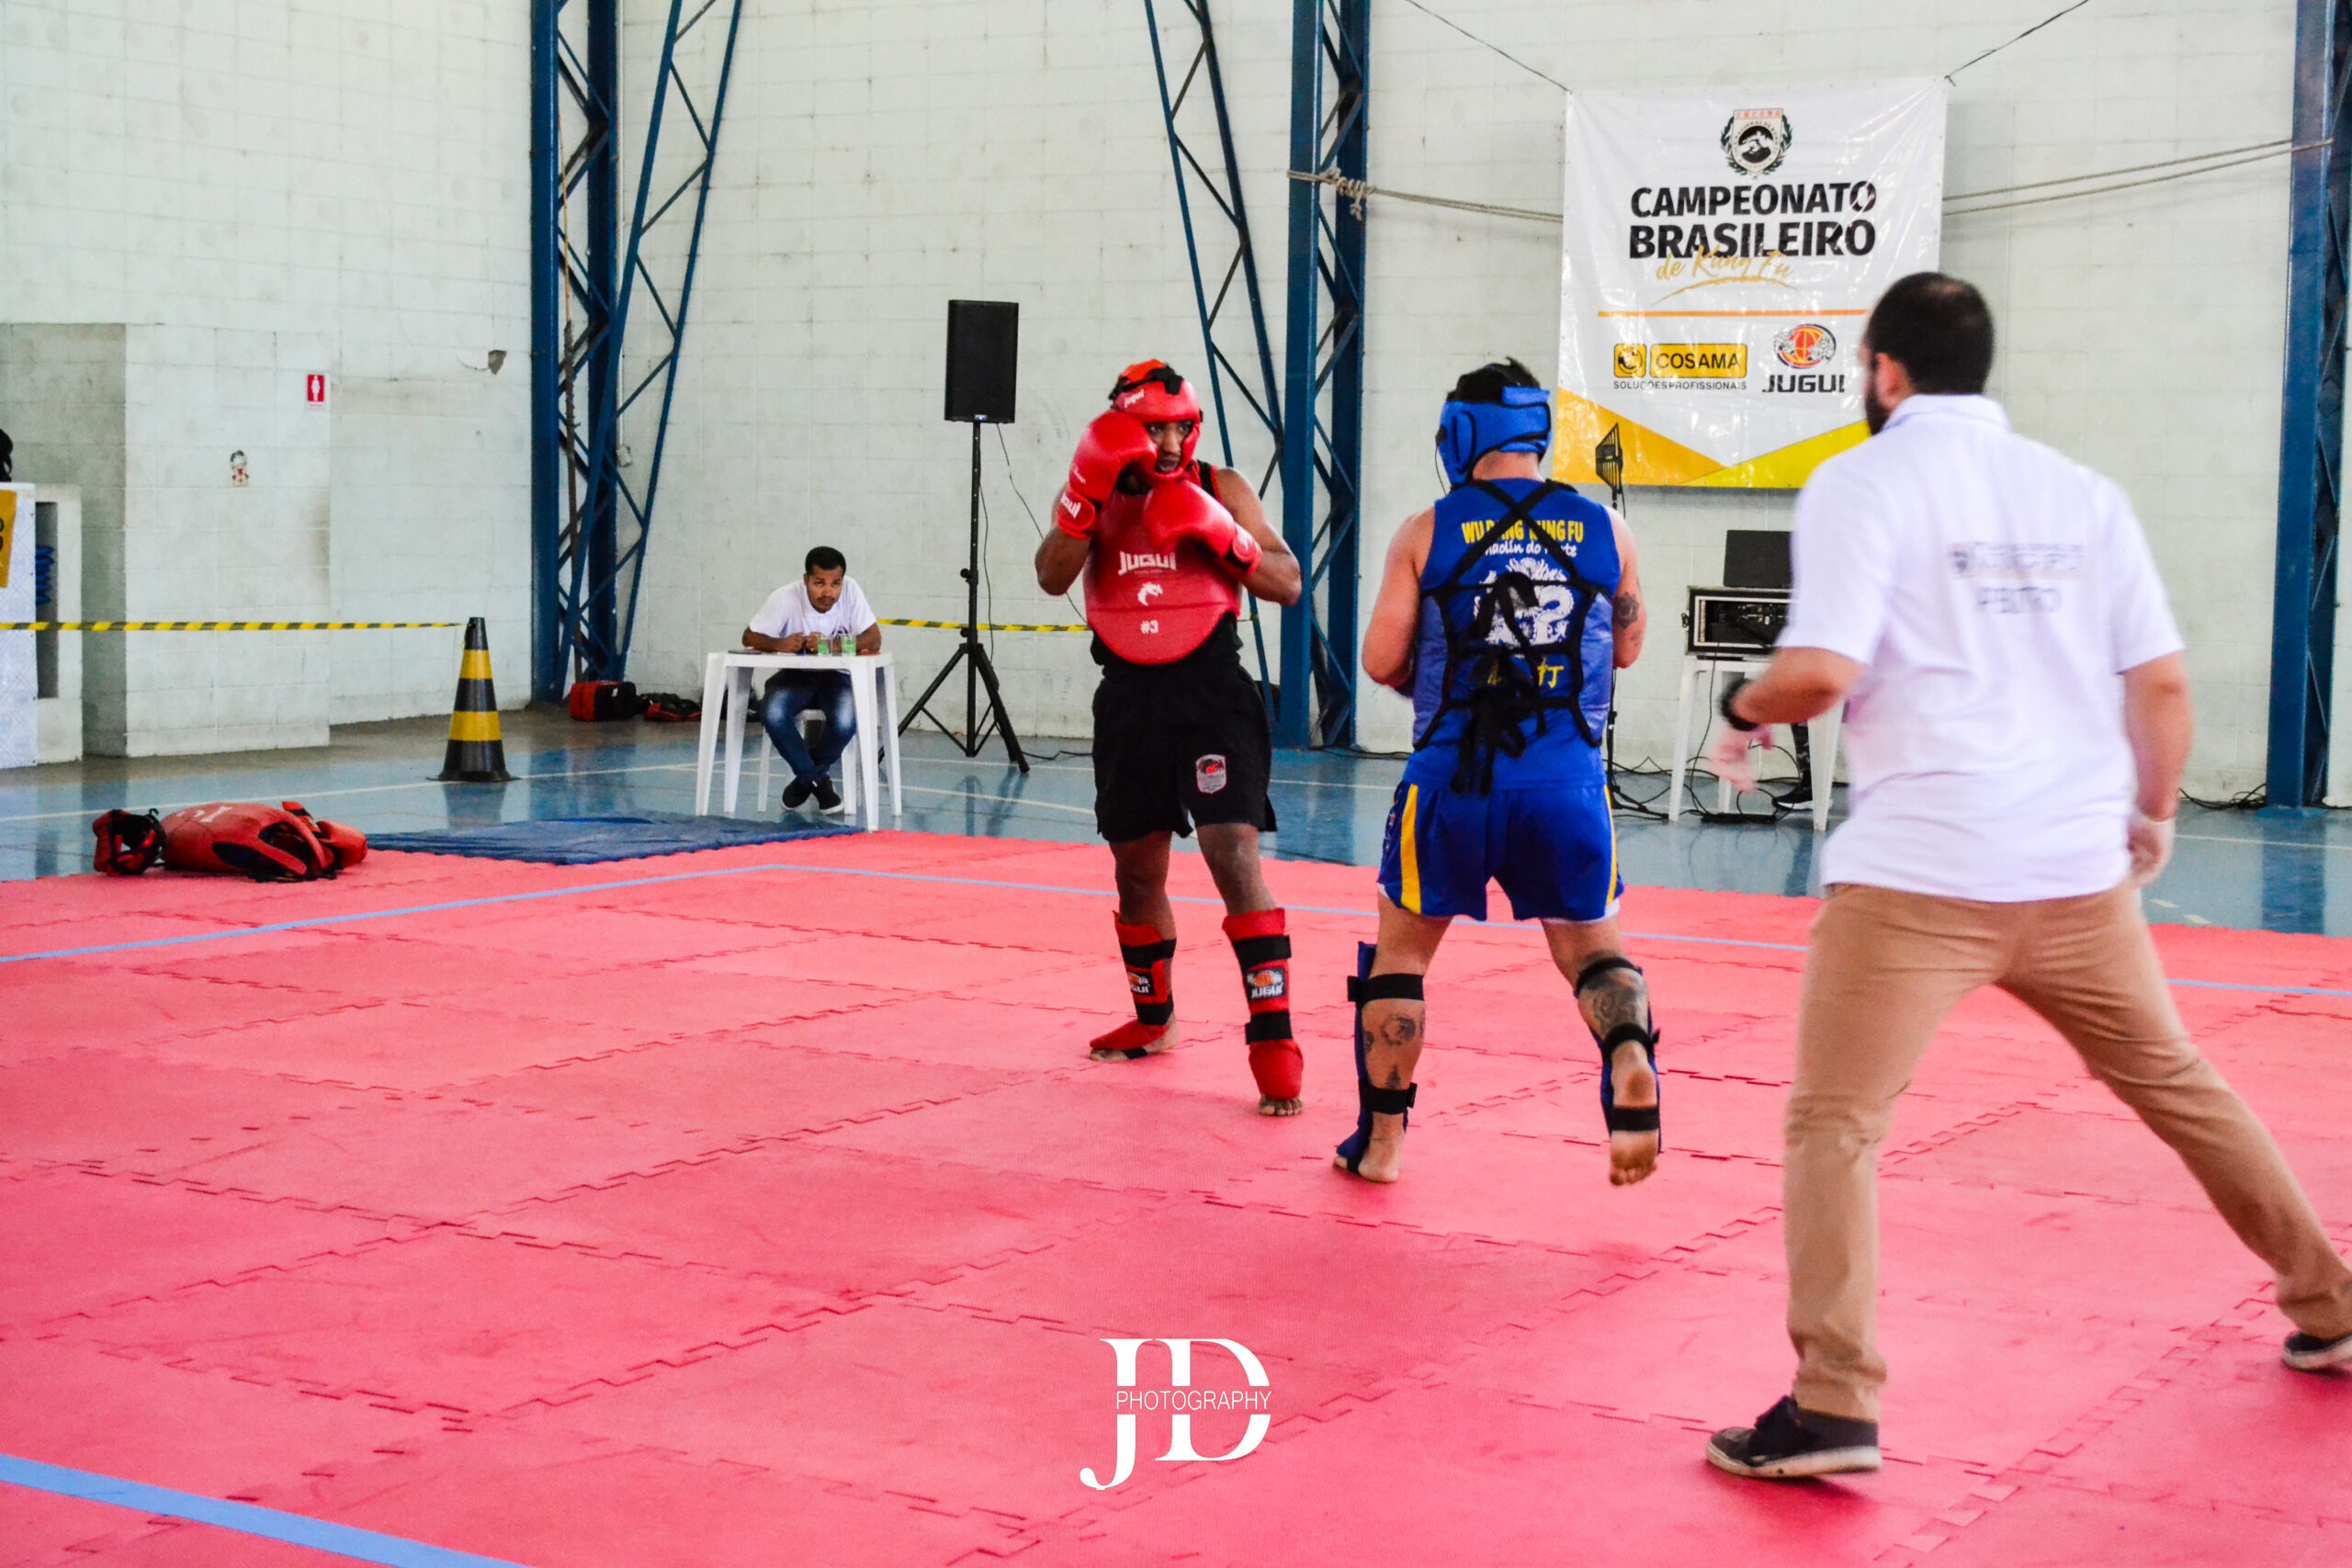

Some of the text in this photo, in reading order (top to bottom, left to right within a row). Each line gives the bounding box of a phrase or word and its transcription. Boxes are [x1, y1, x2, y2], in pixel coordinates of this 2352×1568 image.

[1631, 181, 1877, 218] CAMPEONATO
[1629, 220, 1876, 259] BRASILEIRO
[1657, 253, 1685, 280] de
[1692, 244, 1752, 277] Kung
[1657, 353, 1740, 369] COSAMA
[1761, 375, 1845, 393] JUGUI
[1567, 520, 1583, 543] FU
[1525, 539, 1542, 555] do
